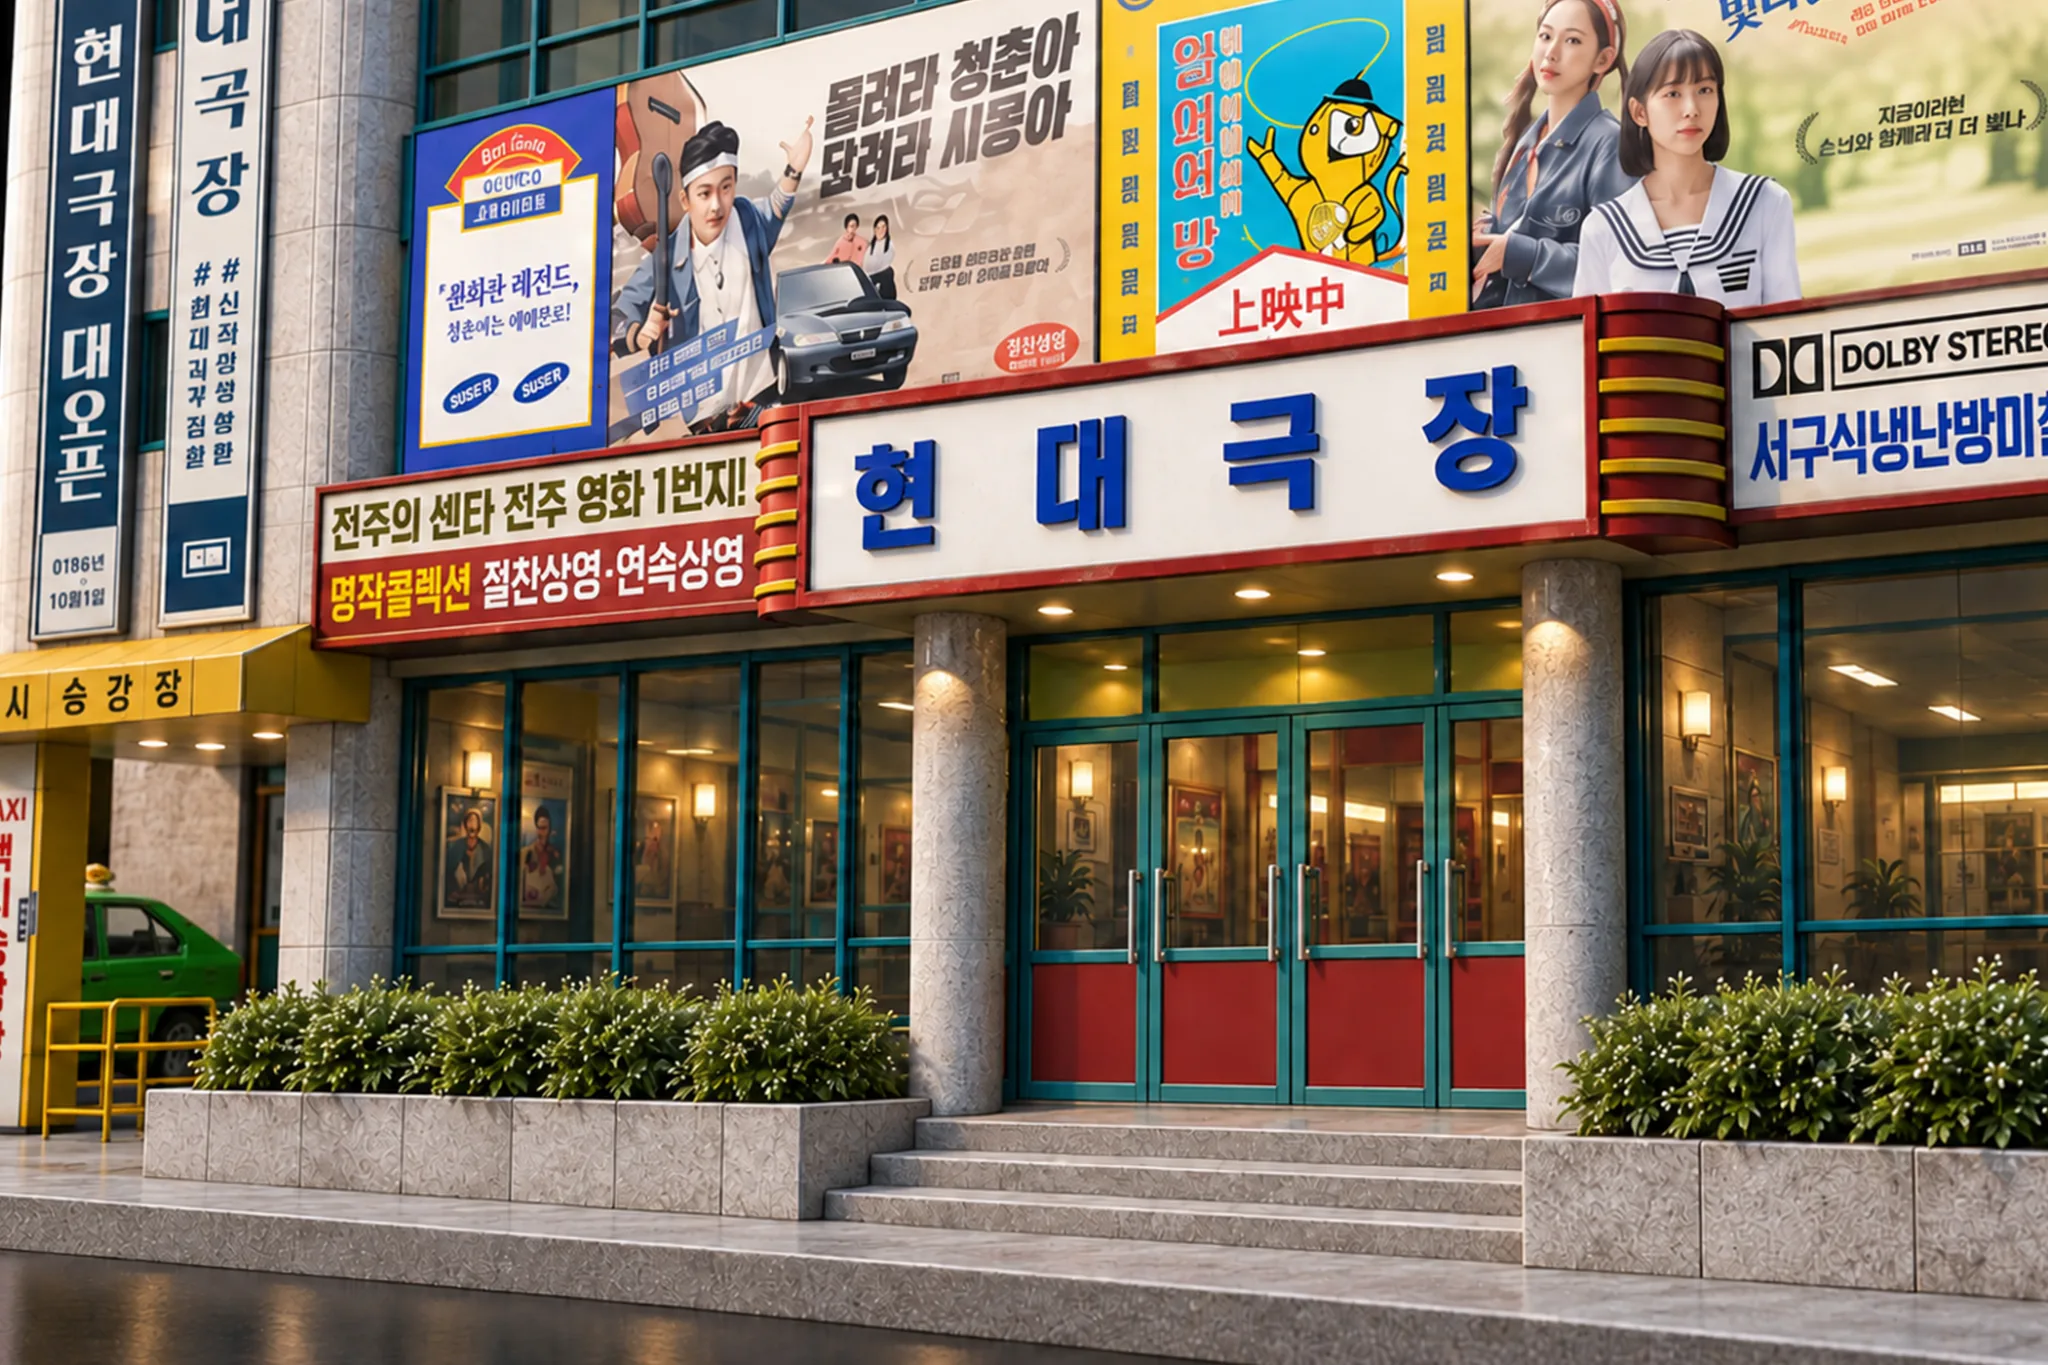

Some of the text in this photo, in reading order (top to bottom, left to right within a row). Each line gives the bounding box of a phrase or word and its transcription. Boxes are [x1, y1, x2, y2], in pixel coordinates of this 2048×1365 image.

[949, 10, 1081, 103] 청춘아
[63, 23, 123, 299] 현대극장
[1218, 276, 1345, 337] 上映中
[1841, 322, 2048, 374] DOLBY STERE
[449, 367, 562, 410] SUSER SUSER
[854, 364, 1529, 551] 현대극장
[331, 456, 748, 551] 전주의 센타 전주 영화 1번지!
[330, 562, 471, 623] 명작콜렉션
